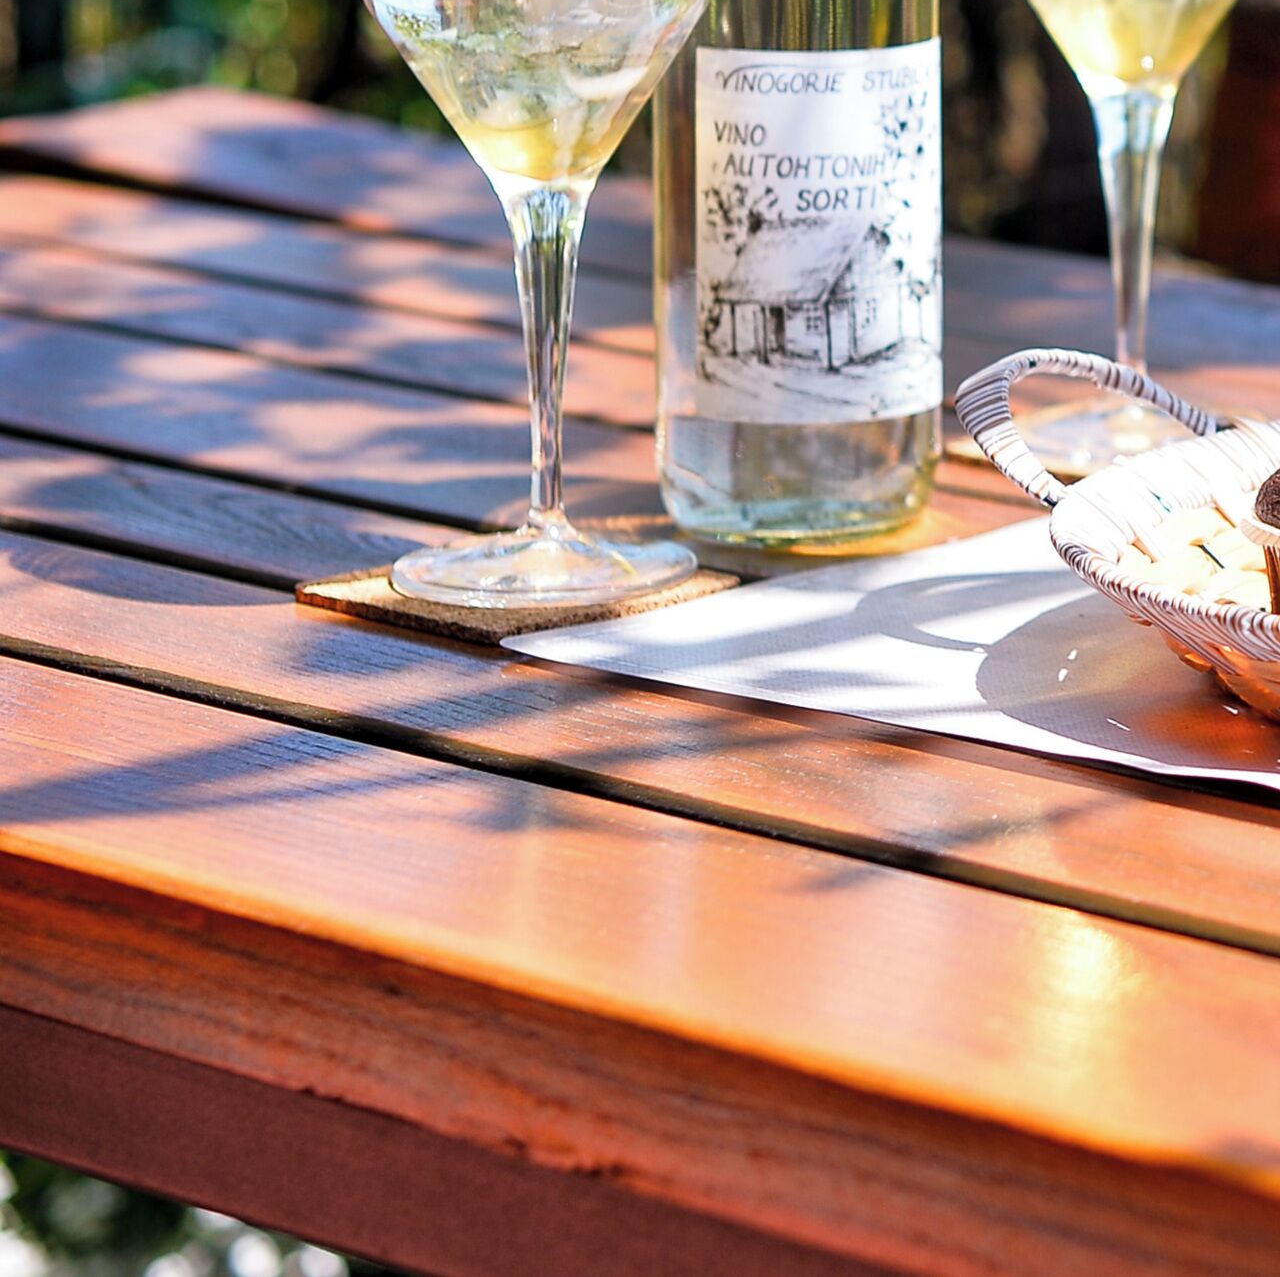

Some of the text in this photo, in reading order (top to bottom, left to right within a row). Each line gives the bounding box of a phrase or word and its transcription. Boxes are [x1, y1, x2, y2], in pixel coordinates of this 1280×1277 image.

[714, 65, 844, 94] VINOGORJE
[714, 121, 767, 147] VINO
[723, 152, 886, 180] AUTOHTONIH
[796, 186, 878, 212] SORTI
